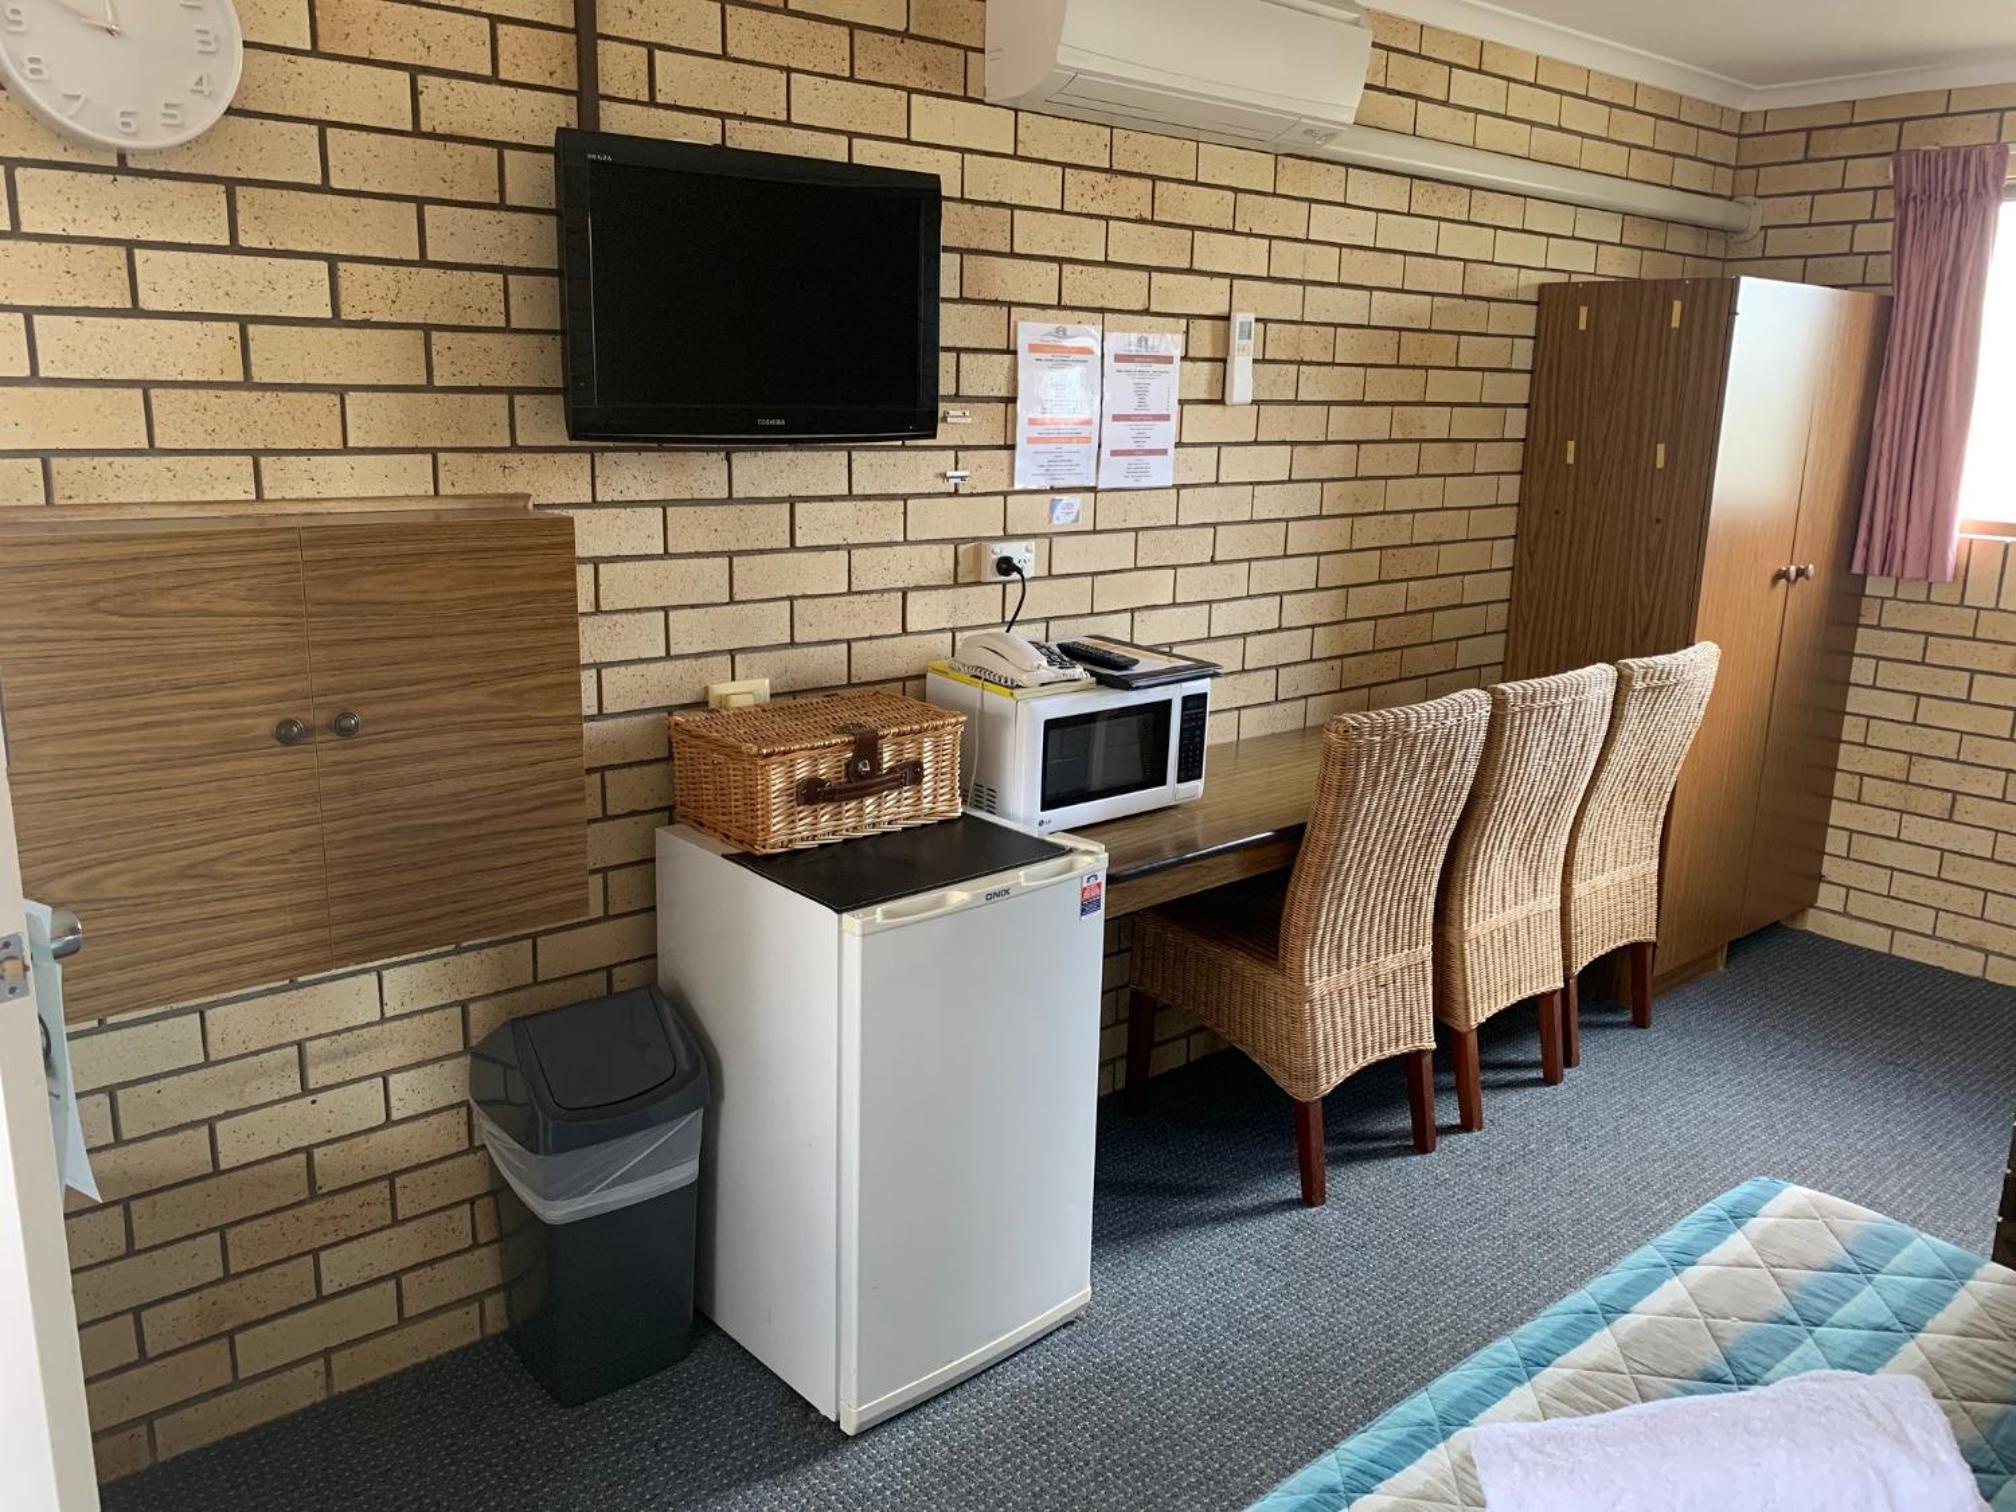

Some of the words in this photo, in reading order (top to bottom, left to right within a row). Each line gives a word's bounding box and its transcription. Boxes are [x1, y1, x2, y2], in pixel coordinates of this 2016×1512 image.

[3, 5, 28, 34] 9
[193, 27, 219, 55] 3
[22, 54, 49, 81] 8
[187, 71, 213, 98] 4
[60, 89, 87, 120] 7
[159, 100, 184, 128] 5
[116, 108, 141, 136] 6
[757, 418, 785, 426] TOSHIBA
